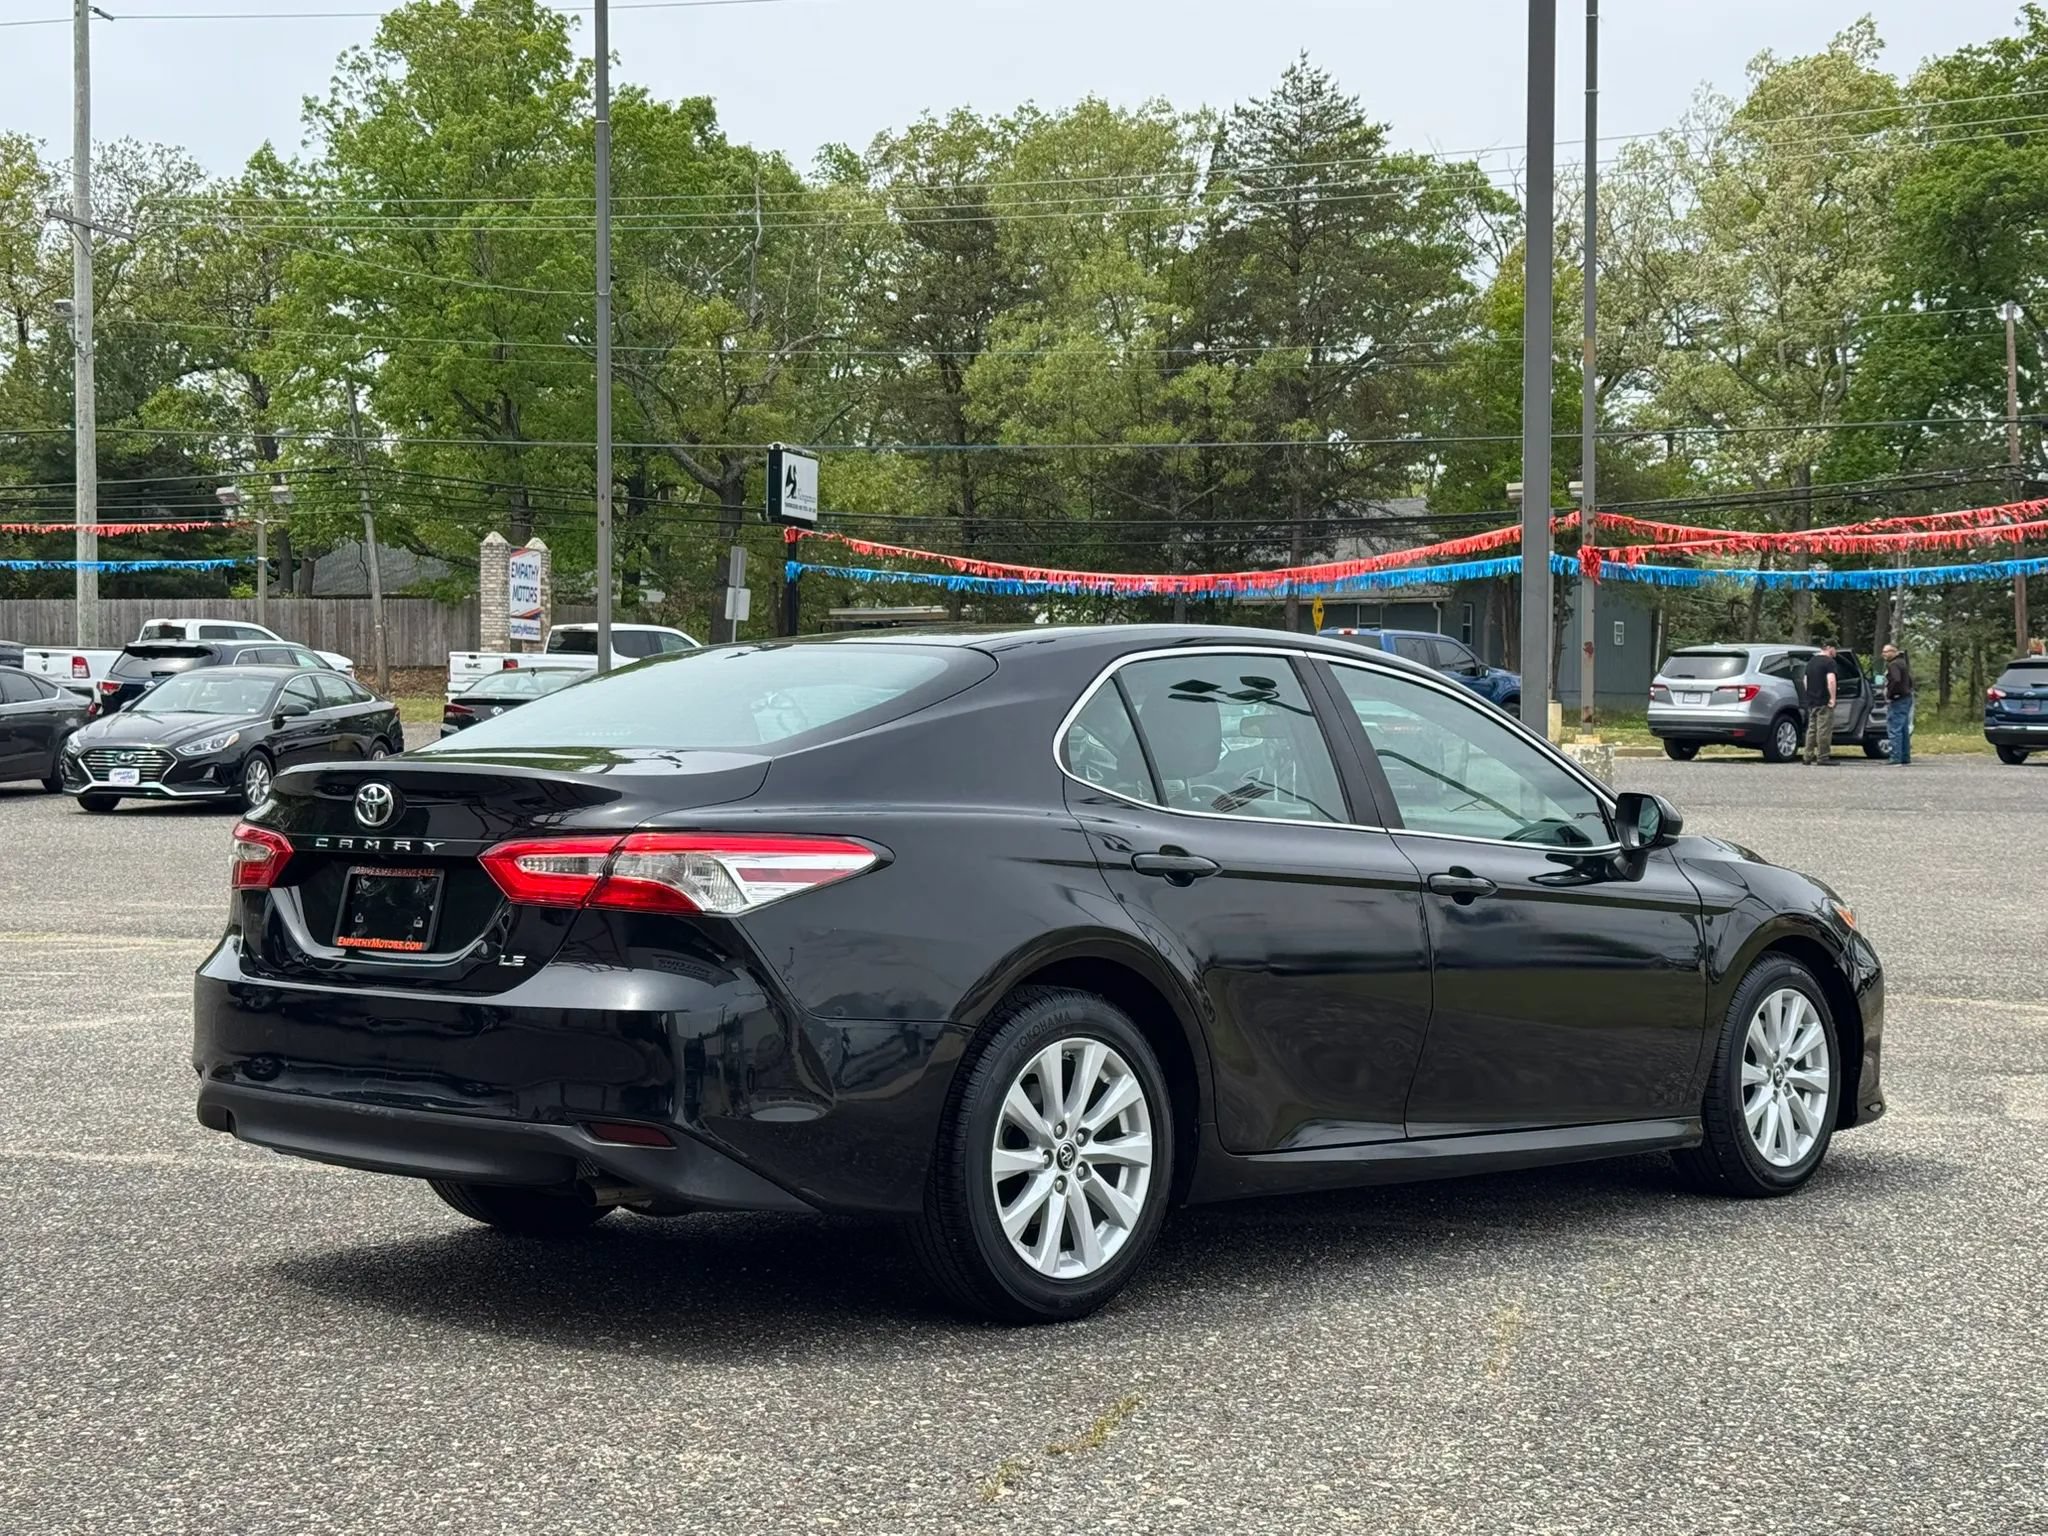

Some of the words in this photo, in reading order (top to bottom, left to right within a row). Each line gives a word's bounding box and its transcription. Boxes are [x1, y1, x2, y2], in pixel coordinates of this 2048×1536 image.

[511, 562, 539, 581] EMPATHY
[512, 584, 538, 603] MOTORS
[315, 838, 446, 852] CAMRY
[355, 866, 375, 875] DRIVE
[498, 954, 527, 967] LE
[1013, 1010, 1072, 1052] YOKOHAMA
